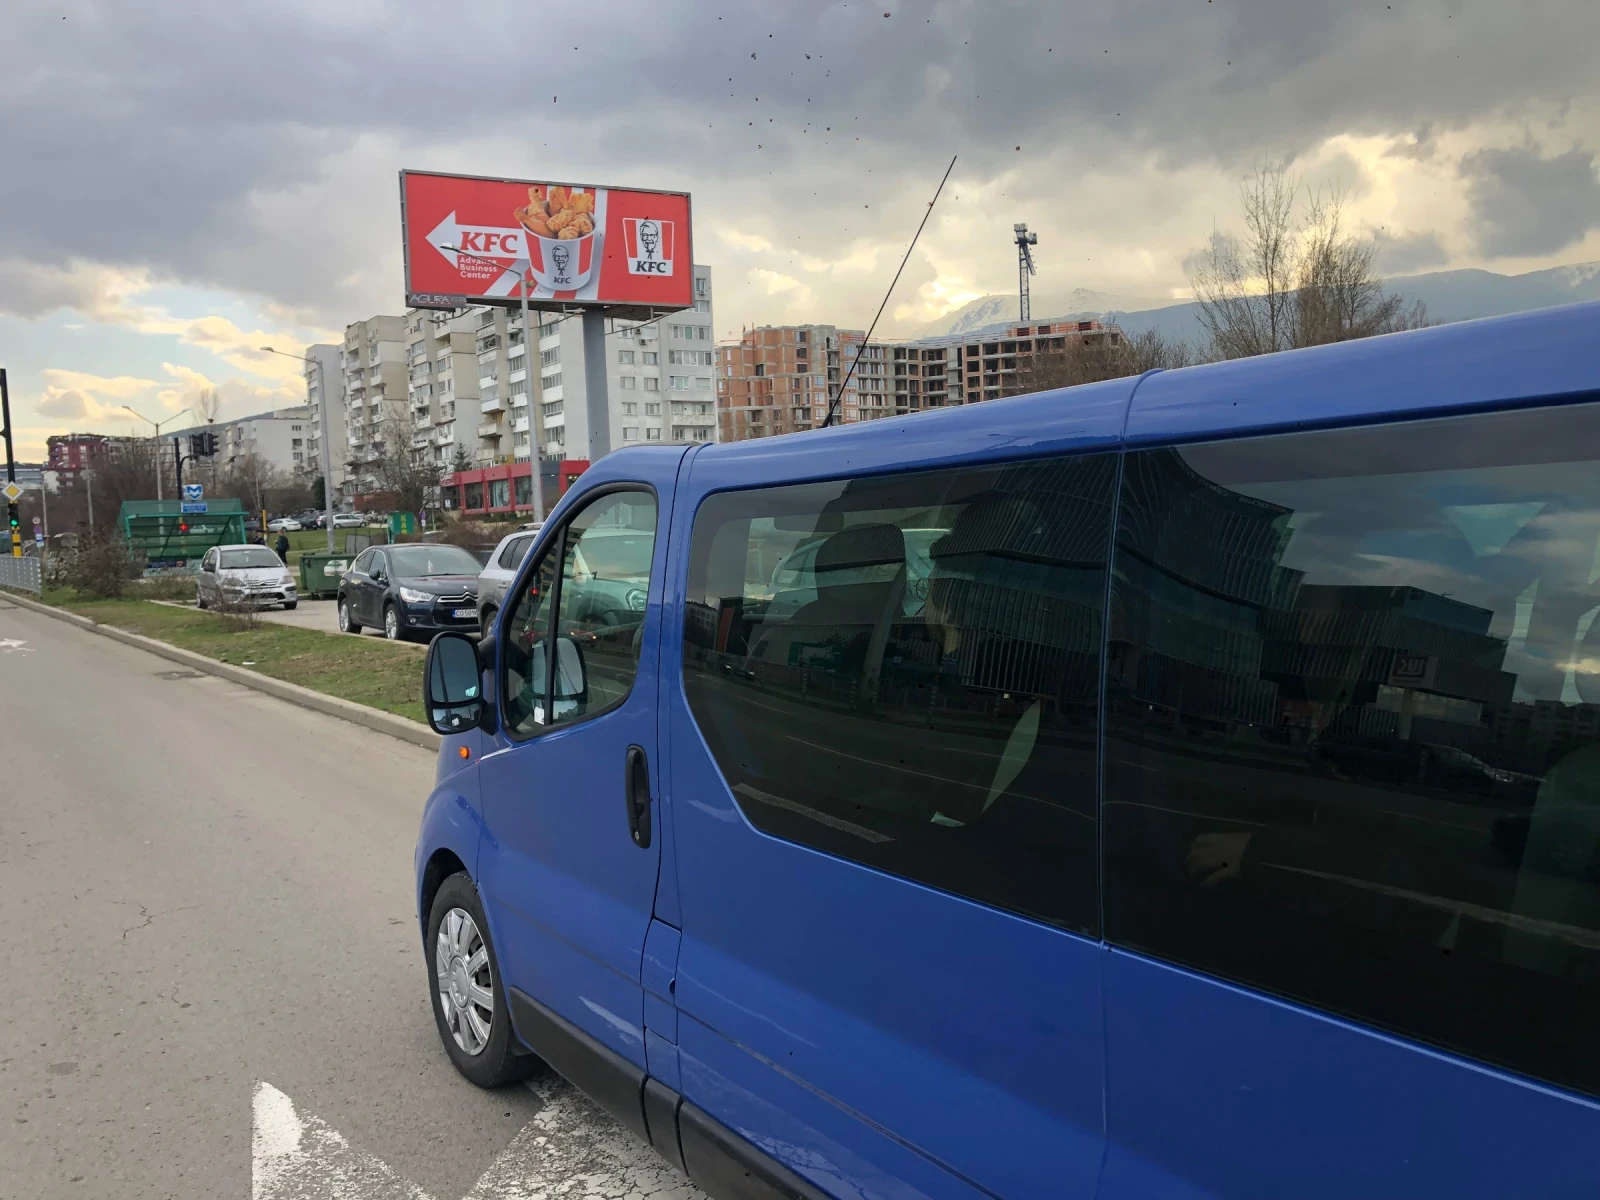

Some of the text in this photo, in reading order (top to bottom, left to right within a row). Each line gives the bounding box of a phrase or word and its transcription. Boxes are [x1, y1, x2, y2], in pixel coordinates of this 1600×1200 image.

[460, 231, 518, 253] KFC
[460, 263, 497, 272] Business
[635, 260, 666, 273] KFC
[460, 271, 491, 279] Center
